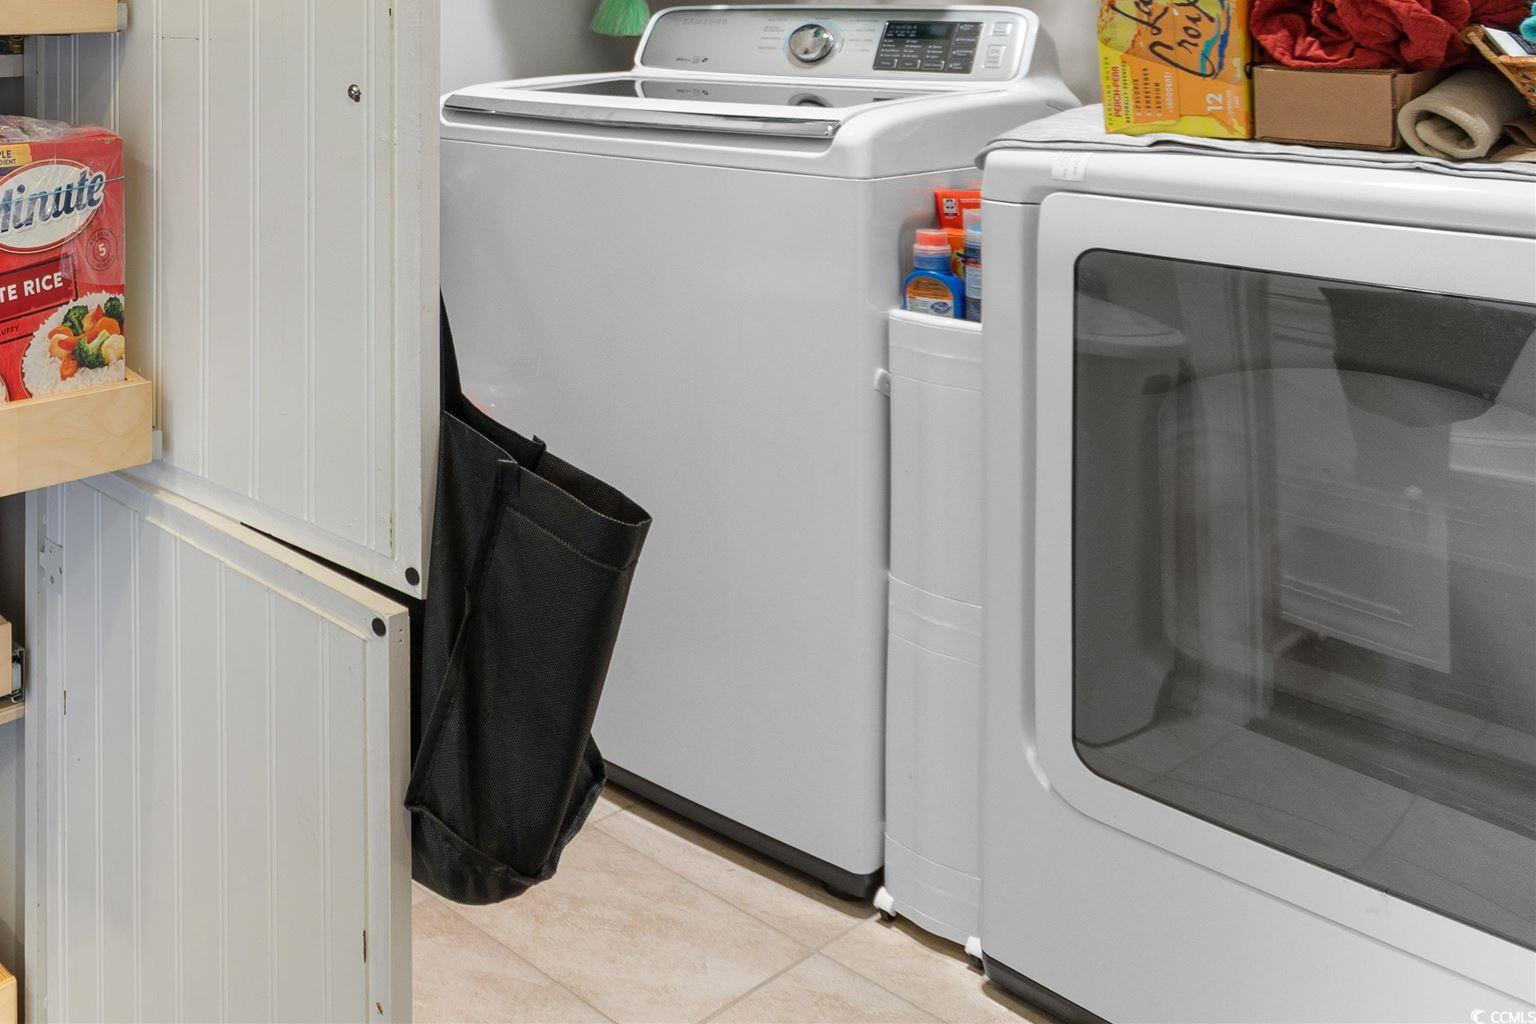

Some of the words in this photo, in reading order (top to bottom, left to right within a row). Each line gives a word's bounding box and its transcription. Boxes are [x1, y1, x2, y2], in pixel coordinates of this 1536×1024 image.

[1111, 66, 1122, 117] PEACH-PEAR
[1206, 93, 1223, 112] 12
[98, 244, 107, 257] 5
[24, 271, 64, 298] RICE
